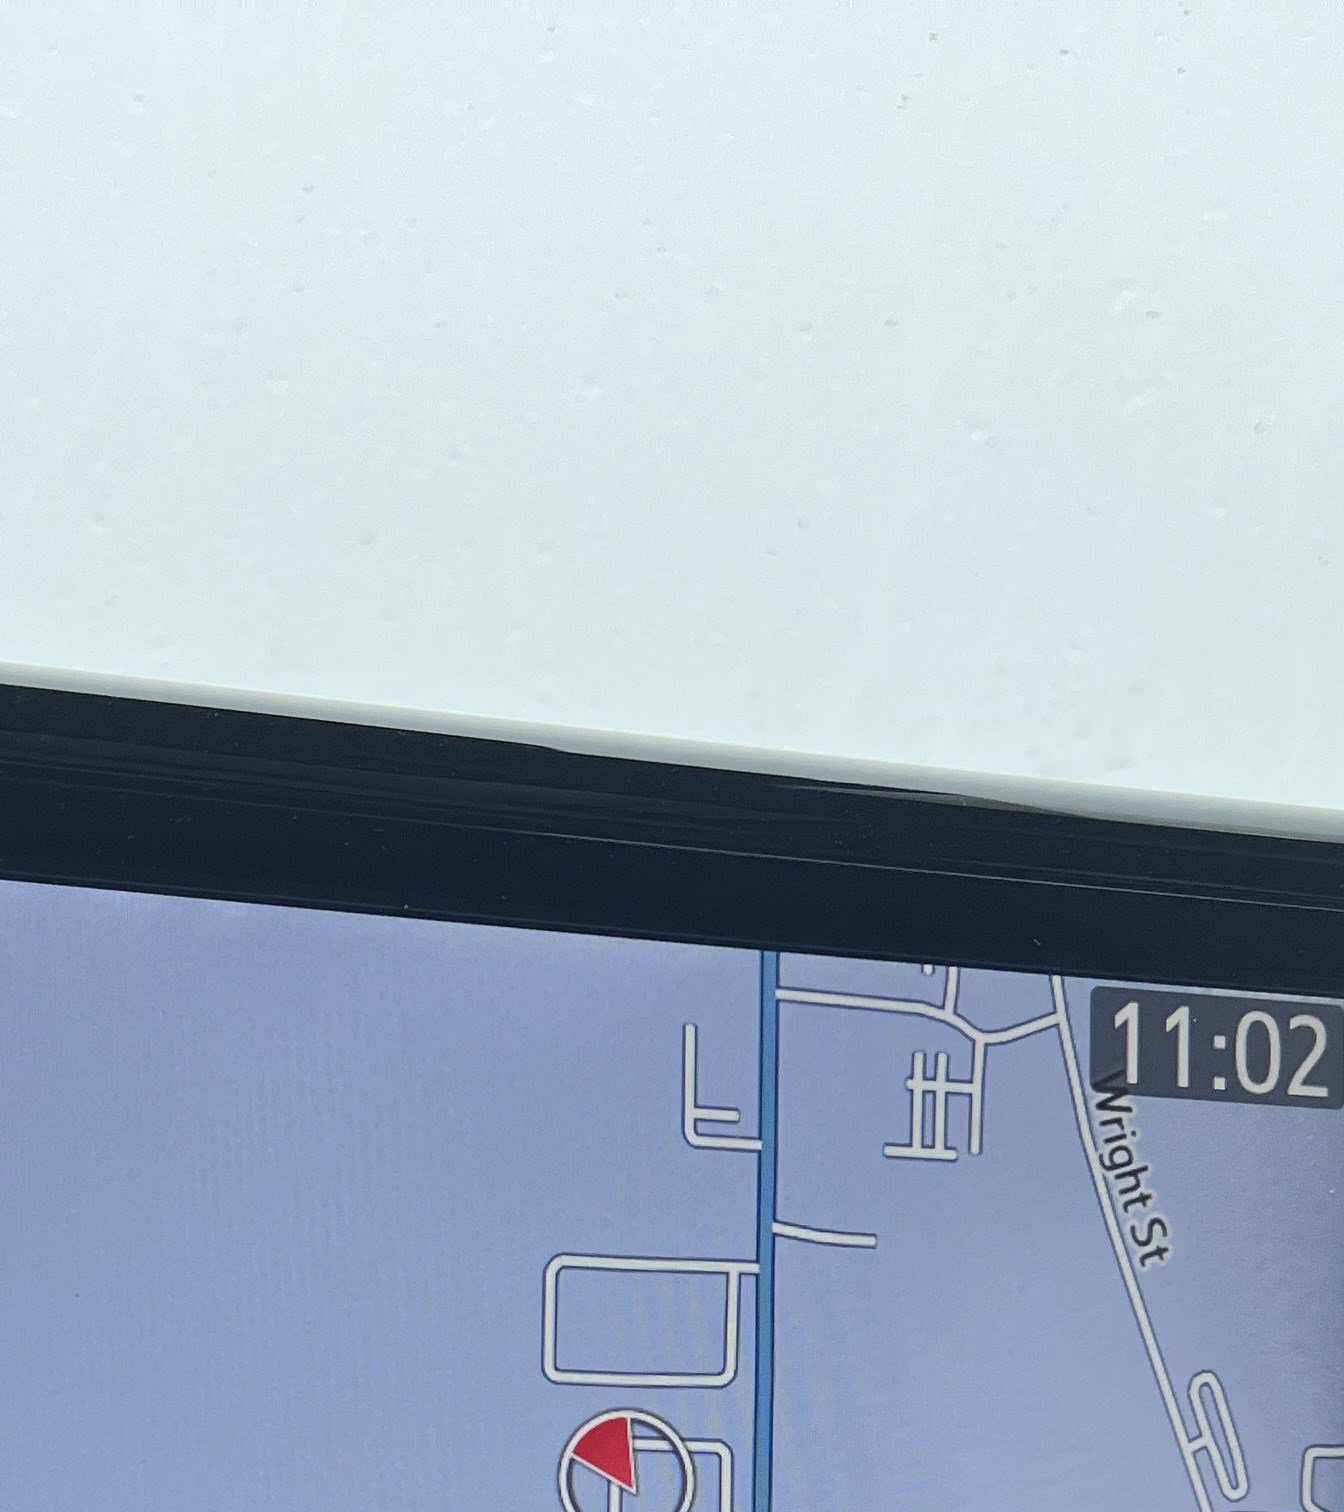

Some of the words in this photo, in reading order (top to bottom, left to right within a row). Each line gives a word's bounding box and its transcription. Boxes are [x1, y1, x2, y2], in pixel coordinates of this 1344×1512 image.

[1113, 1000, 1330, 1098] 11:02
[1090, 1068, 1153, 1214] Wright
[1129, 1216, 1170, 1269] St
